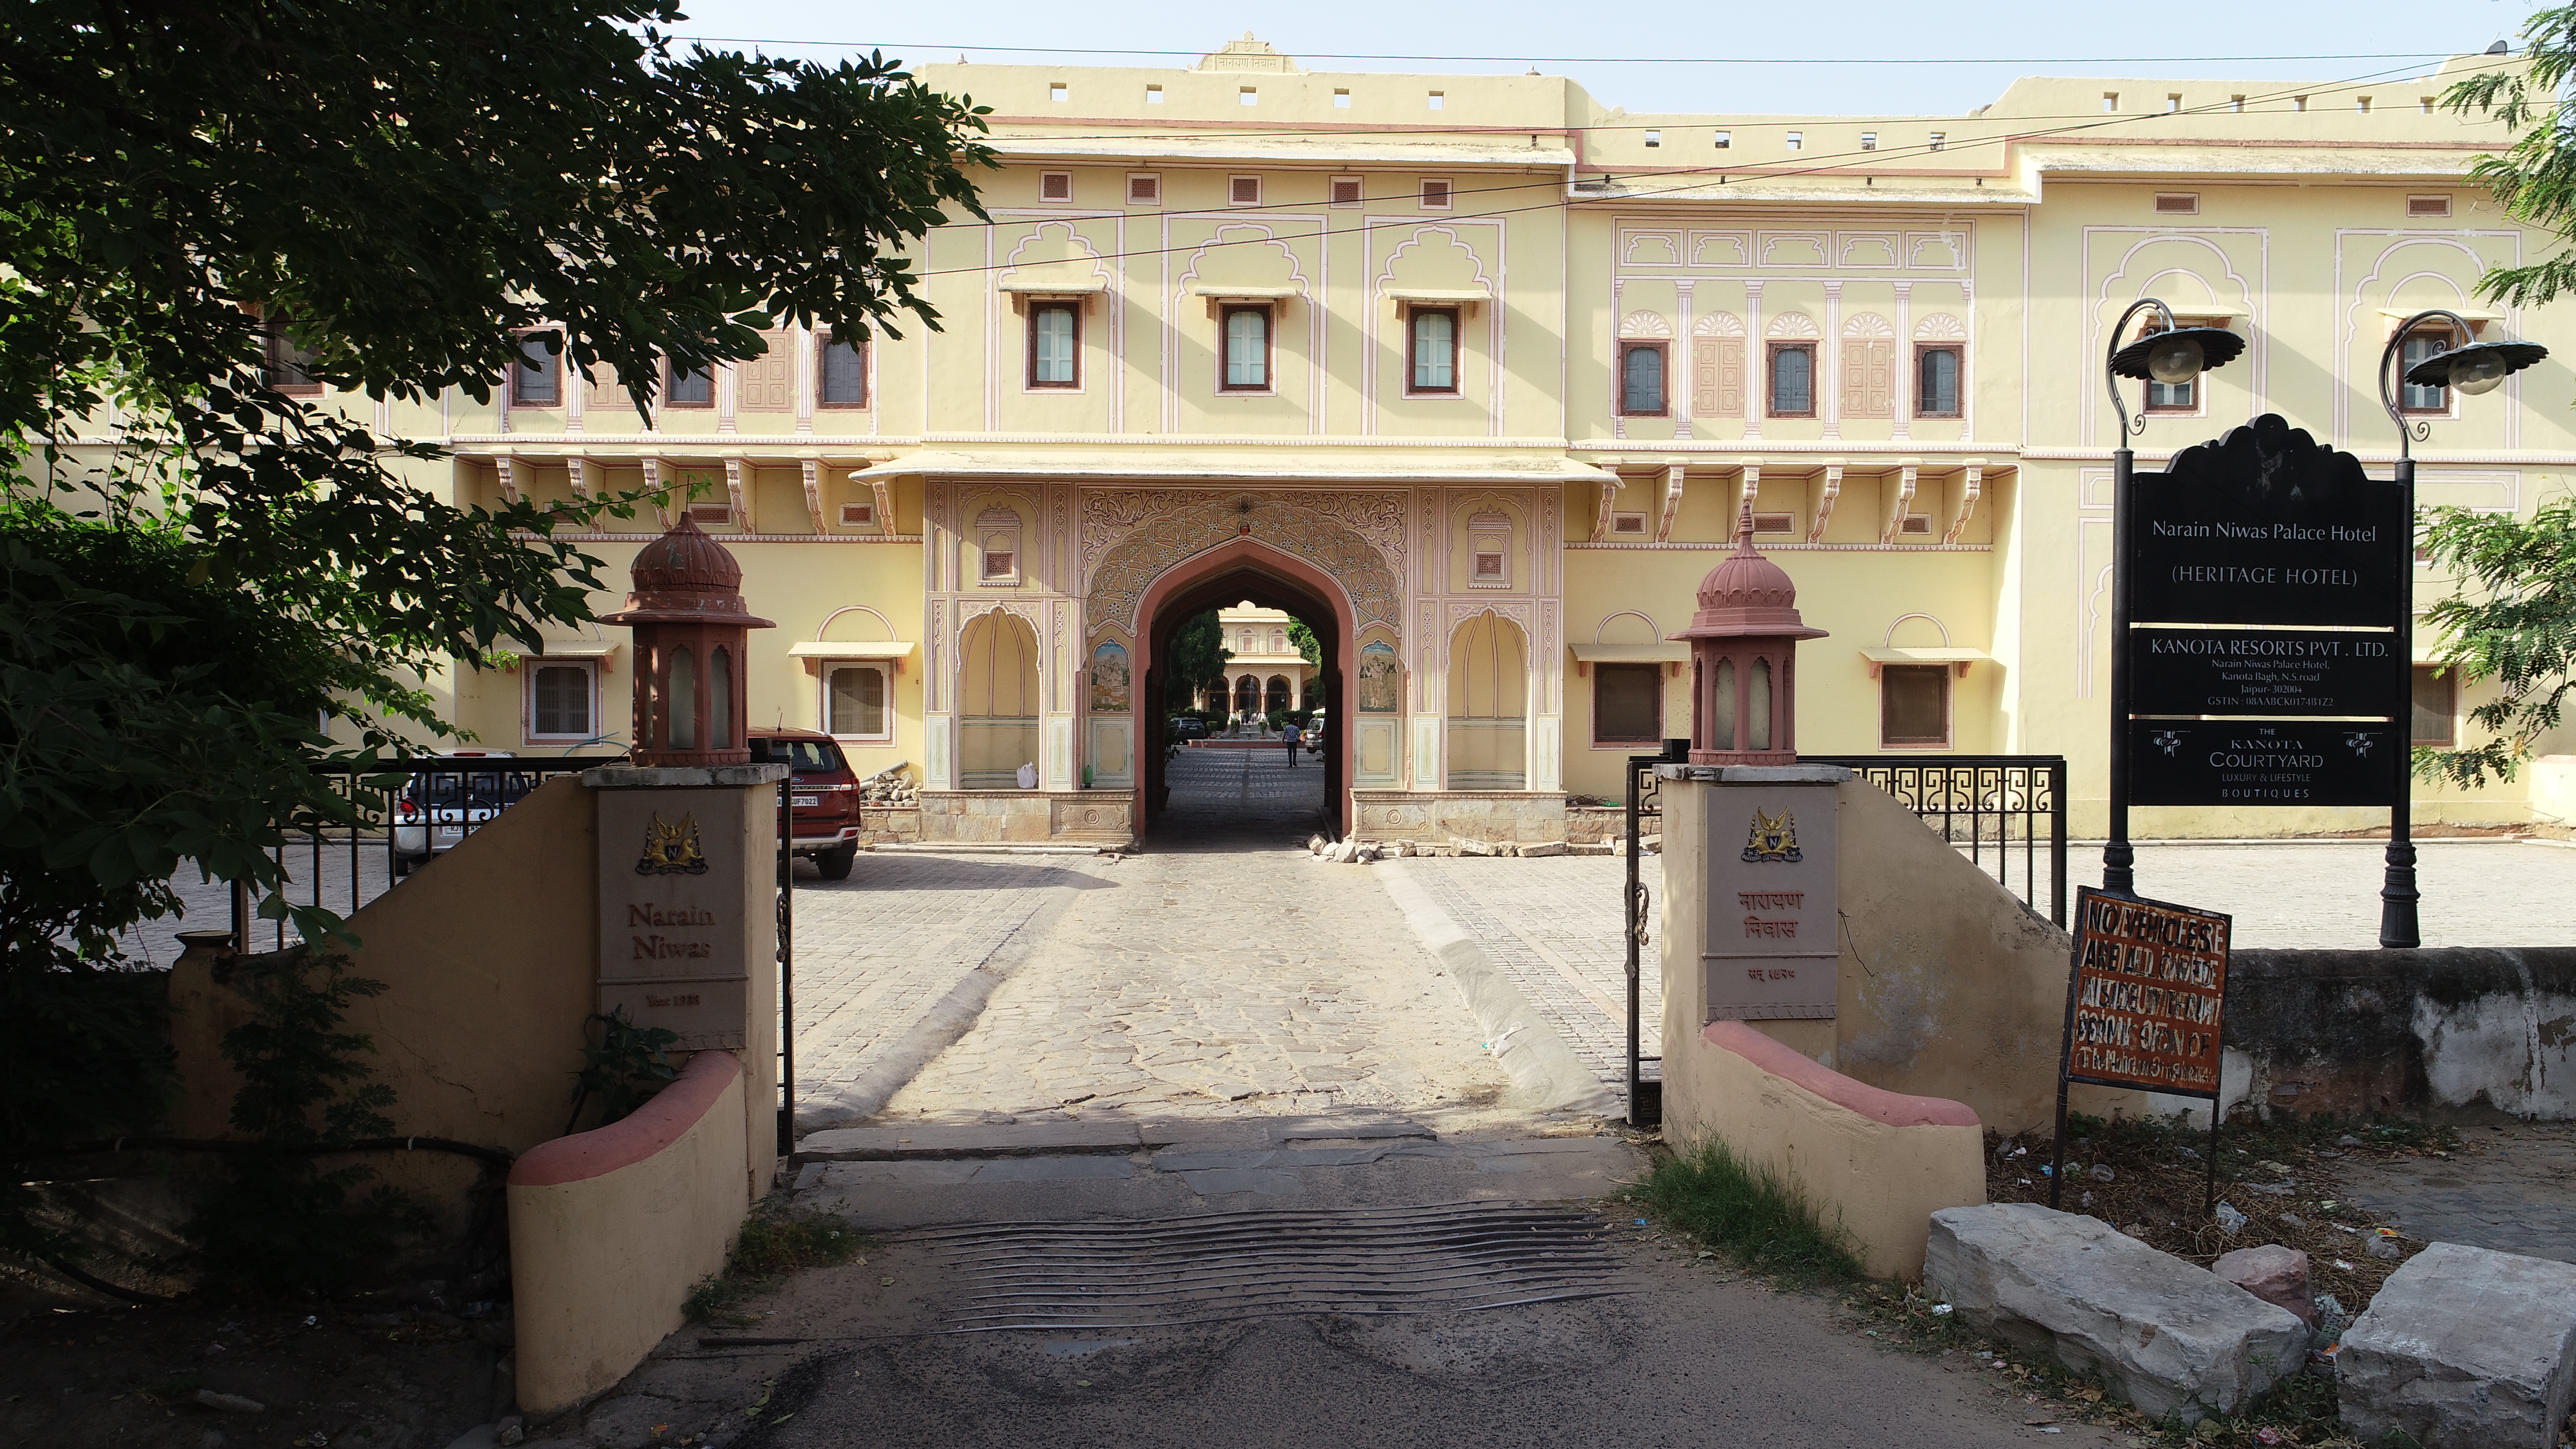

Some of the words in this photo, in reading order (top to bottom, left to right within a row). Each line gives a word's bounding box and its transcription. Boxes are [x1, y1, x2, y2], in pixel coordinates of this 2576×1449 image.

[2153, 520, 2209, 537] Narain
[2216, 522, 2268, 539] Niwas
[2274, 523, 2326, 540] Palace
[2331, 525, 2375, 542] Hotel
[2173, 565, 2276, 583] (HERITAGE
[2286, 568, 2357, 587] HOTEL)
[2152, 639, 2225, 654] KANOTA
[2230, 640, 2304, 656] RESORTS
[2356, 642, 2388, 657] LTD.
[2212, 659, 2241, 668] Narain
[2244, 660, 2271, 668] Niwas
[2273, 660, 2300, 668] Palace
[2303, 660, 2330, 670] Hotel,
[2222, 672, 2253, 680] Kanota
[2255, 672, 2279, 683] Bagh,
[2241, 684, 2270, 695] Jaipur-
[2272, 685, 2302, 693] 302004
[2207, 696, 2238, 705] GSTIN
[2231, 740, 2303, 749] KANOTA
[2222, 773, 2256, 781] LUXURY
[2260, 773, 2267, 781] &
[2270, 773, 2310, 782] LIFESTYLE
[2222, 789, 2309, 798] BOUTIQUES
[1770, 837, 1777, 847] N
[1739, 892, 1804, 910] नारायण
[628, 903, 716, 926] Narain
[1744, 915, 1798, 938] निवास
[633, 935, 711, 959] Niwas
